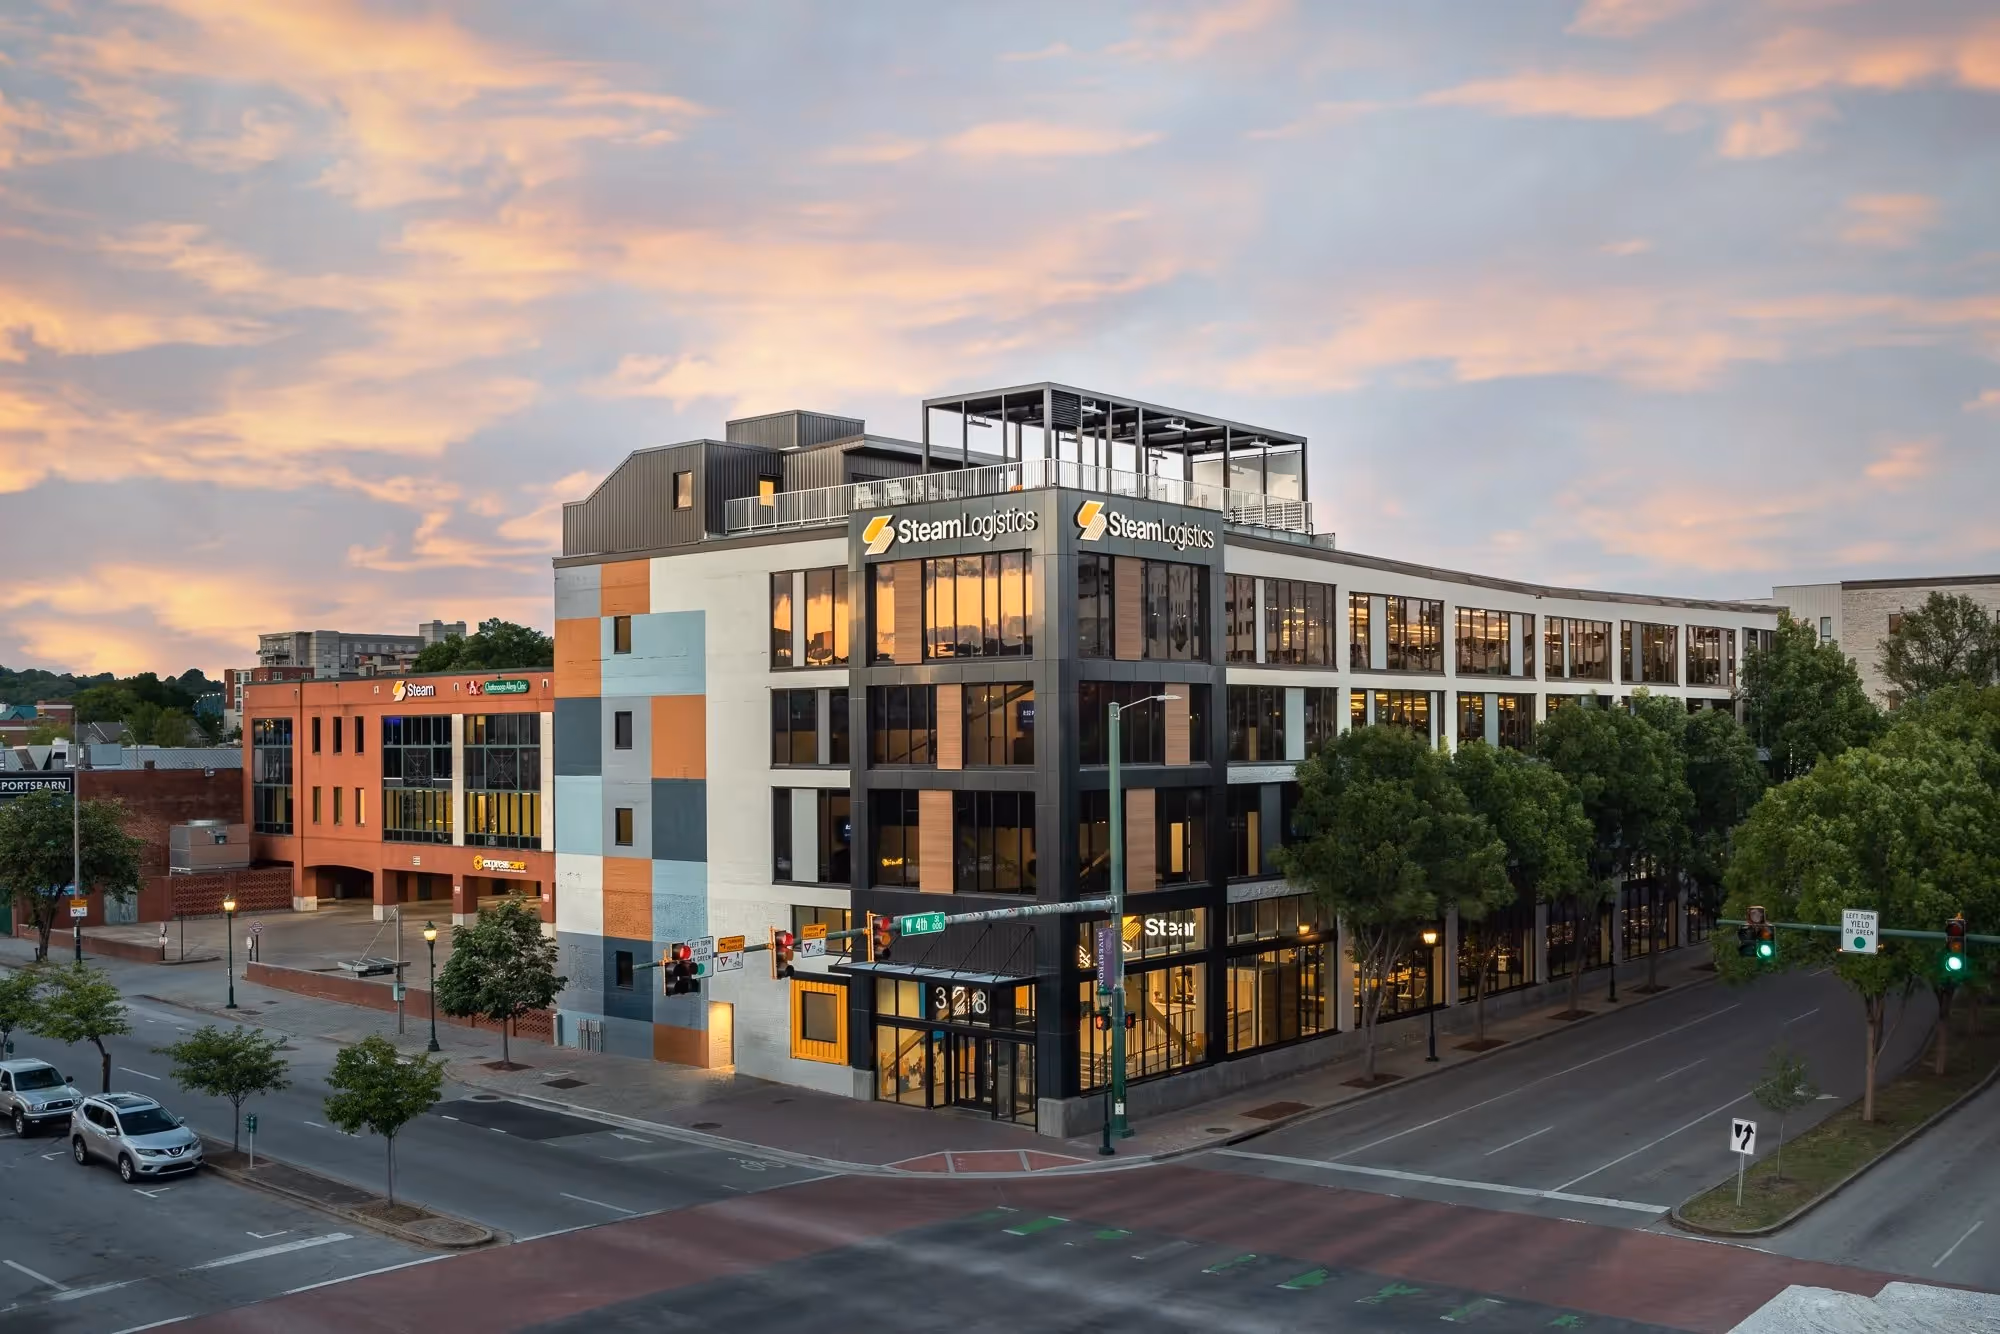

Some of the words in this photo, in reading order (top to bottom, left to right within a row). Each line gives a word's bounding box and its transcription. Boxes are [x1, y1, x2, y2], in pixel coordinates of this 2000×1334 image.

[407, 683, 434, 697] Steam
[0, 781, 66, 790] PORTSBARN
[906, 919, 912, 932] W
[915, 917, 928, 931] 4th
[1851, 920, 1869, 928] YIELD
[700, 939, 711, 947] TURN
[692, 947, 708, 956] YIELD
[935, 986, 987, 1014] 328
